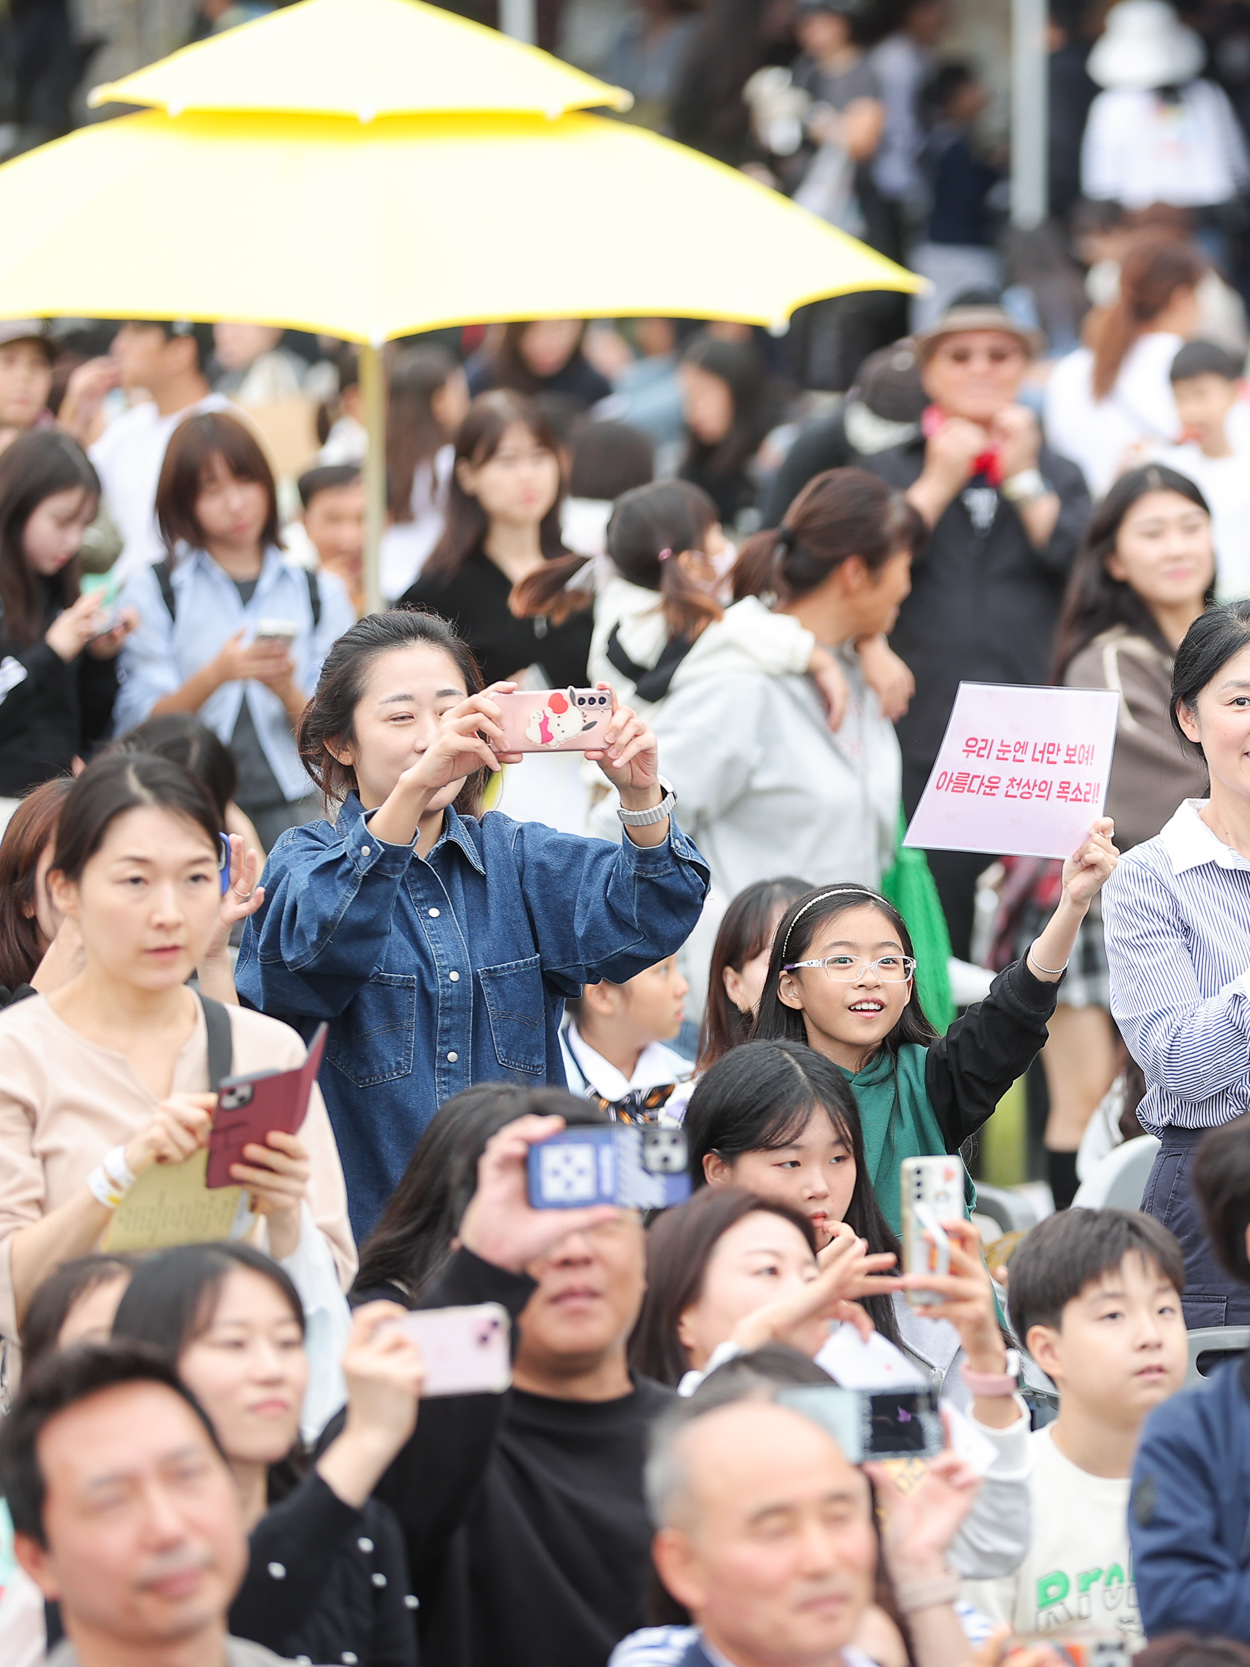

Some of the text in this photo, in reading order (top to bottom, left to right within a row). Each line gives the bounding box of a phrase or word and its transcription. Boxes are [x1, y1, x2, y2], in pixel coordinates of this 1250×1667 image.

[962, 737, 1095, 766] 우리 눈엔 너만 보여!
[935, 771, 1100, 804] 아름다운 천상의 목소리!
